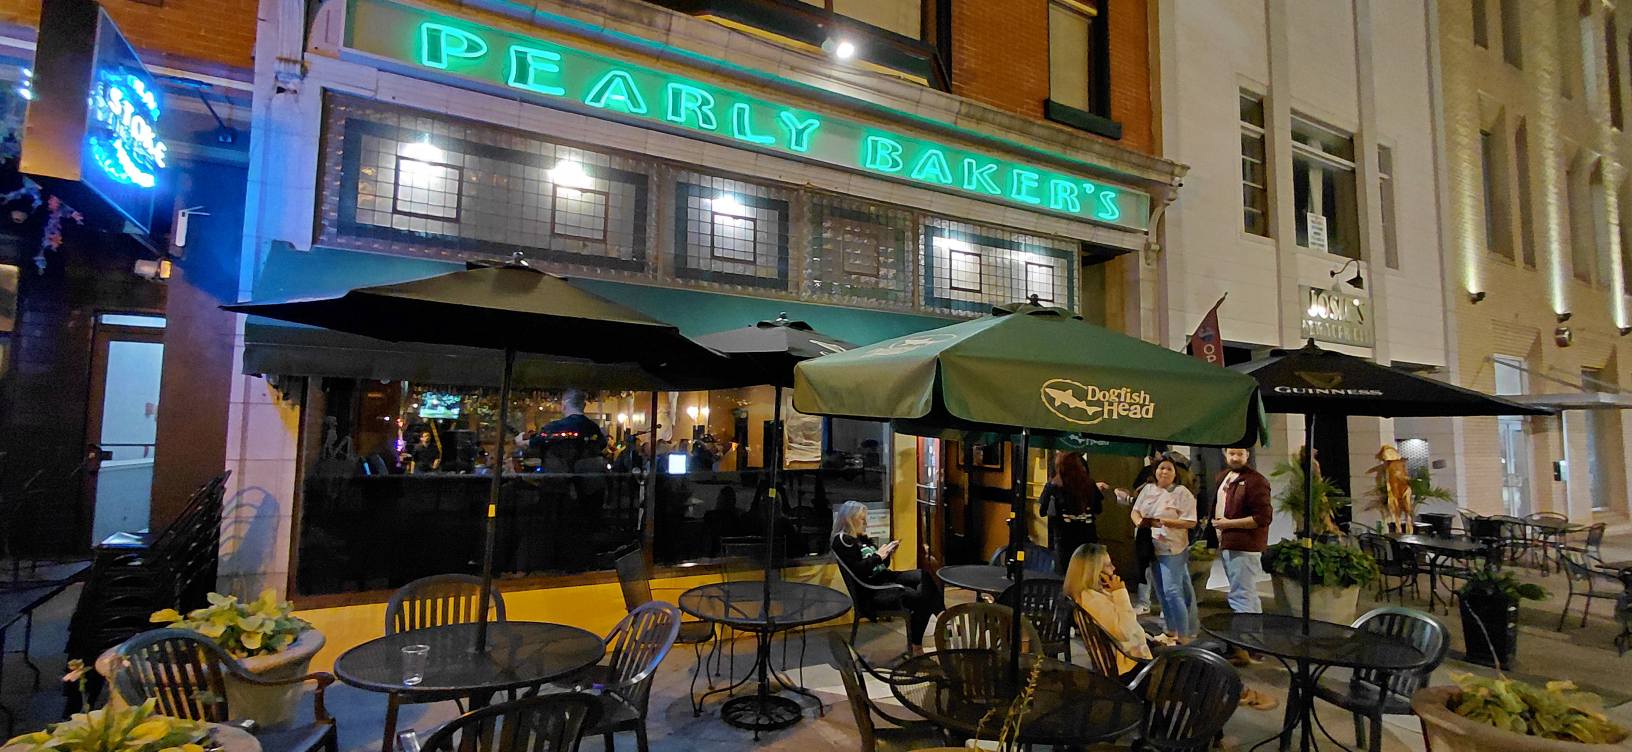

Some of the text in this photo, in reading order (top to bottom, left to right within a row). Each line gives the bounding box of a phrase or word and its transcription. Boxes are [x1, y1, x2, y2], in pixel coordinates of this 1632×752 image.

[419, 21, 1122, 222] PEARLY BAKER'S
[1086, 385, 1151, 405] Dogfish
[1273, 385, 1384, 396] GUINNESS
[1102, 401, 1156, 419] Head
